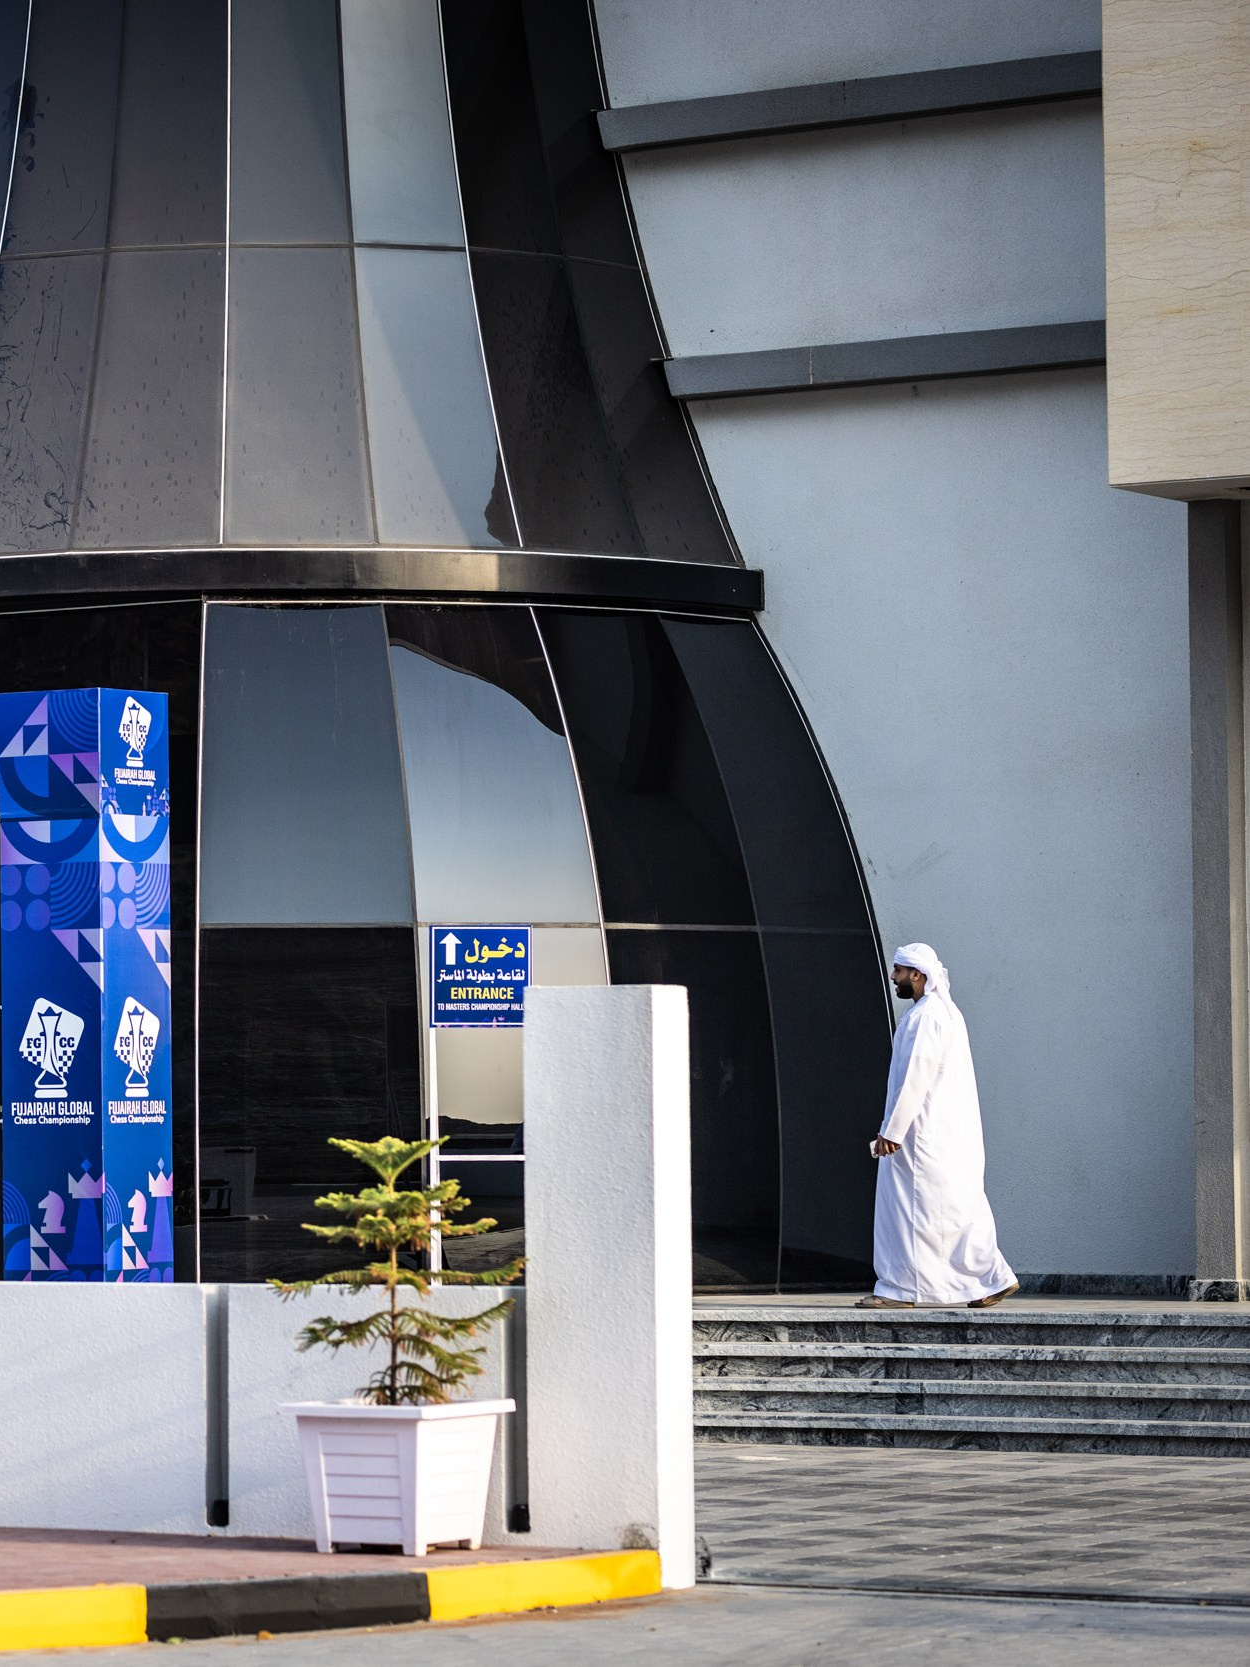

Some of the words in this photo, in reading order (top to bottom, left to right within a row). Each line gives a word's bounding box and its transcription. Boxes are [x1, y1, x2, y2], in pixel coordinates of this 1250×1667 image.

[464, 937, 526, 964] دخول
[466, 969, 495, 984] بطولة
[497, 969, 525, 981] لقاعة
[450, 987, 514, 999] ENTRANCE
[26, 1038, 42, 1049] FG
[59, 1037, 75, 1048] CC
[119, 1036, 130, 1047] FG
[142, 1036, 154, 1047] CC
[11, 1102, 56, 1116] FUJAIRAH
[58, 1101, 94, 1115] GLOBAL
[108, 1101, 141, 1115] FUJAIRAH
[141, 1100, 167, 1114] GLOBAL
[14, 1116, 37, 1125] Chess
[38, 1115, 90, 1126] Championship
[110, 1115, 127, 1123] Chess
[127, 1115, 165, 1125] Championship
